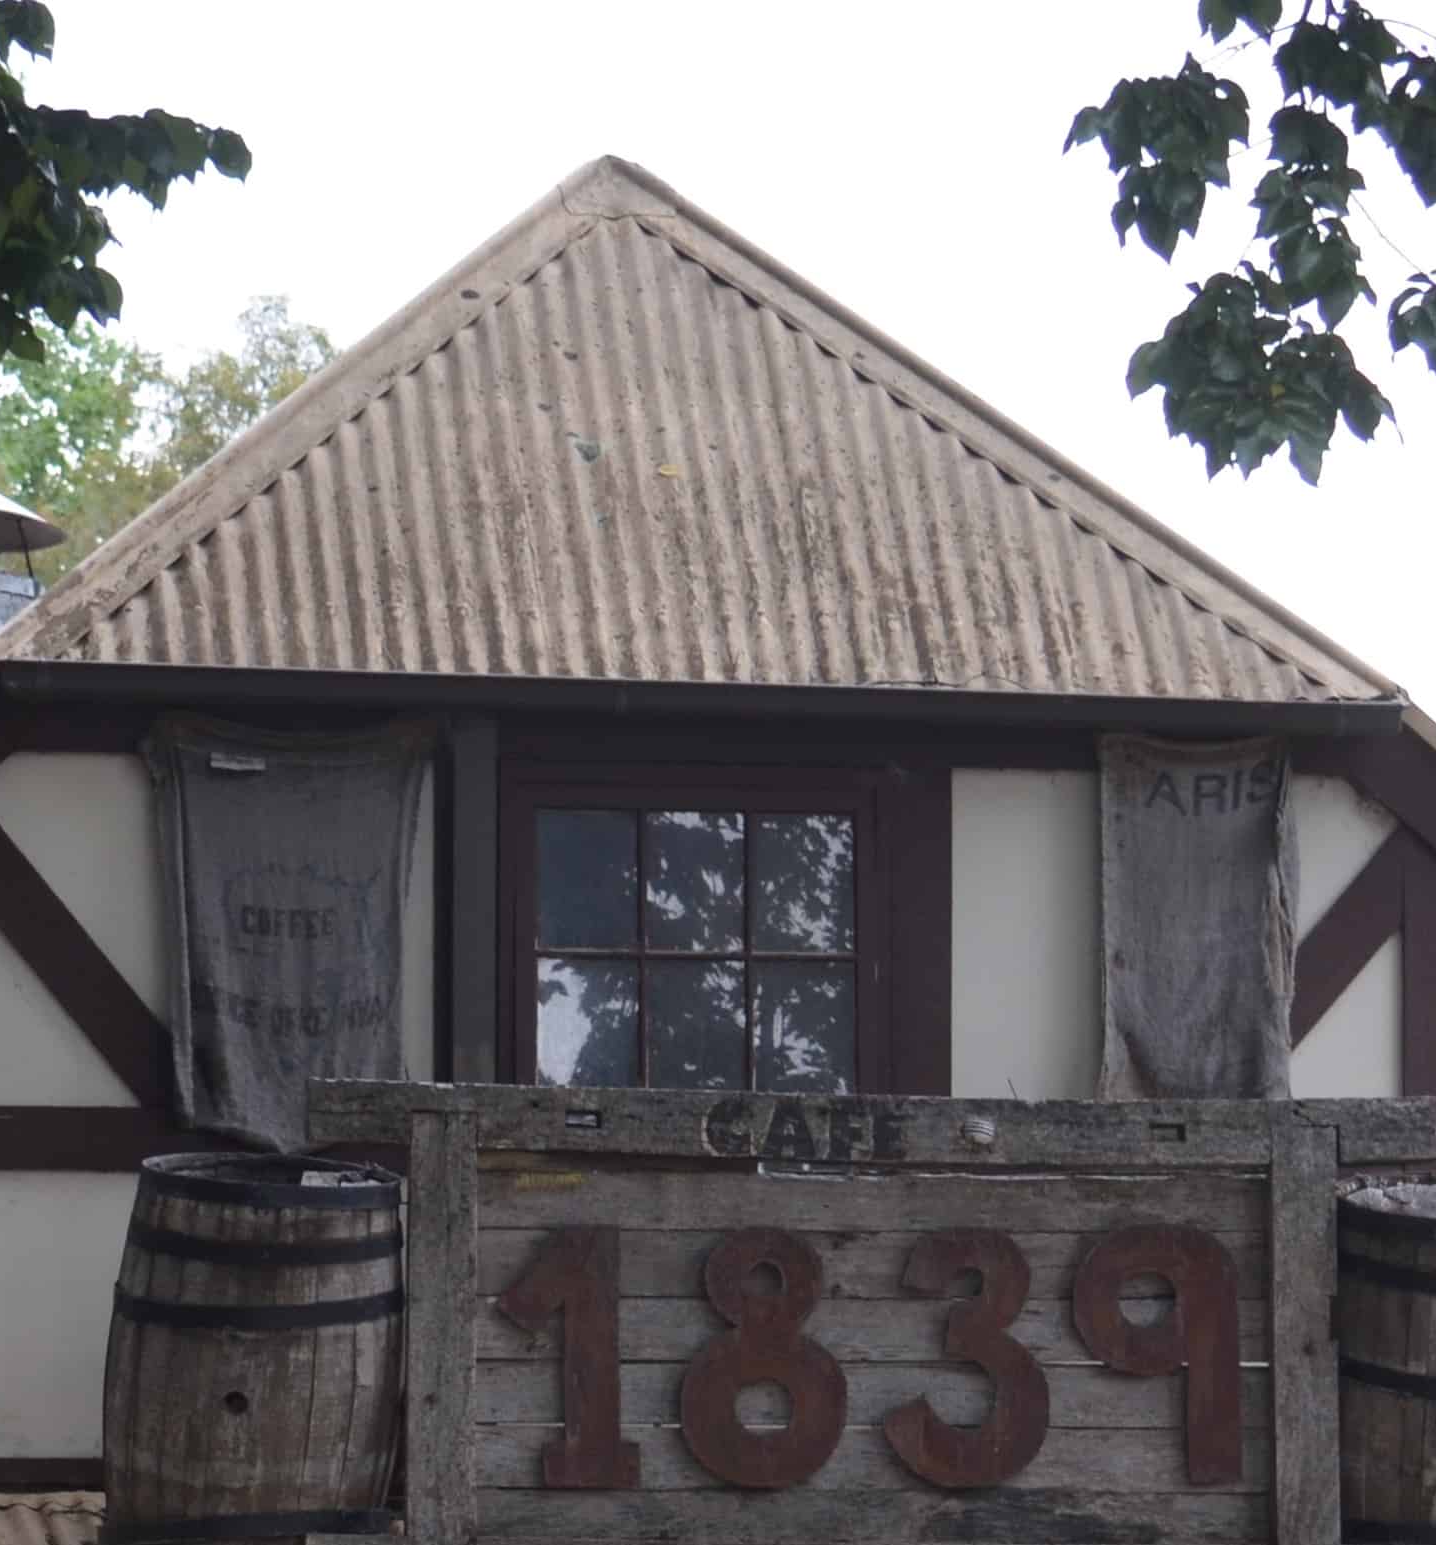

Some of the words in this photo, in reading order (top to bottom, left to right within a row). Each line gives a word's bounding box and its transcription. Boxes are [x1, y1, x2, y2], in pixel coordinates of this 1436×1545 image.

[241, 904, 335, 940] COFFEE
[701, 1099, 907, 1160] CAFE
[496, 1223, 1243, 1489] 1839
